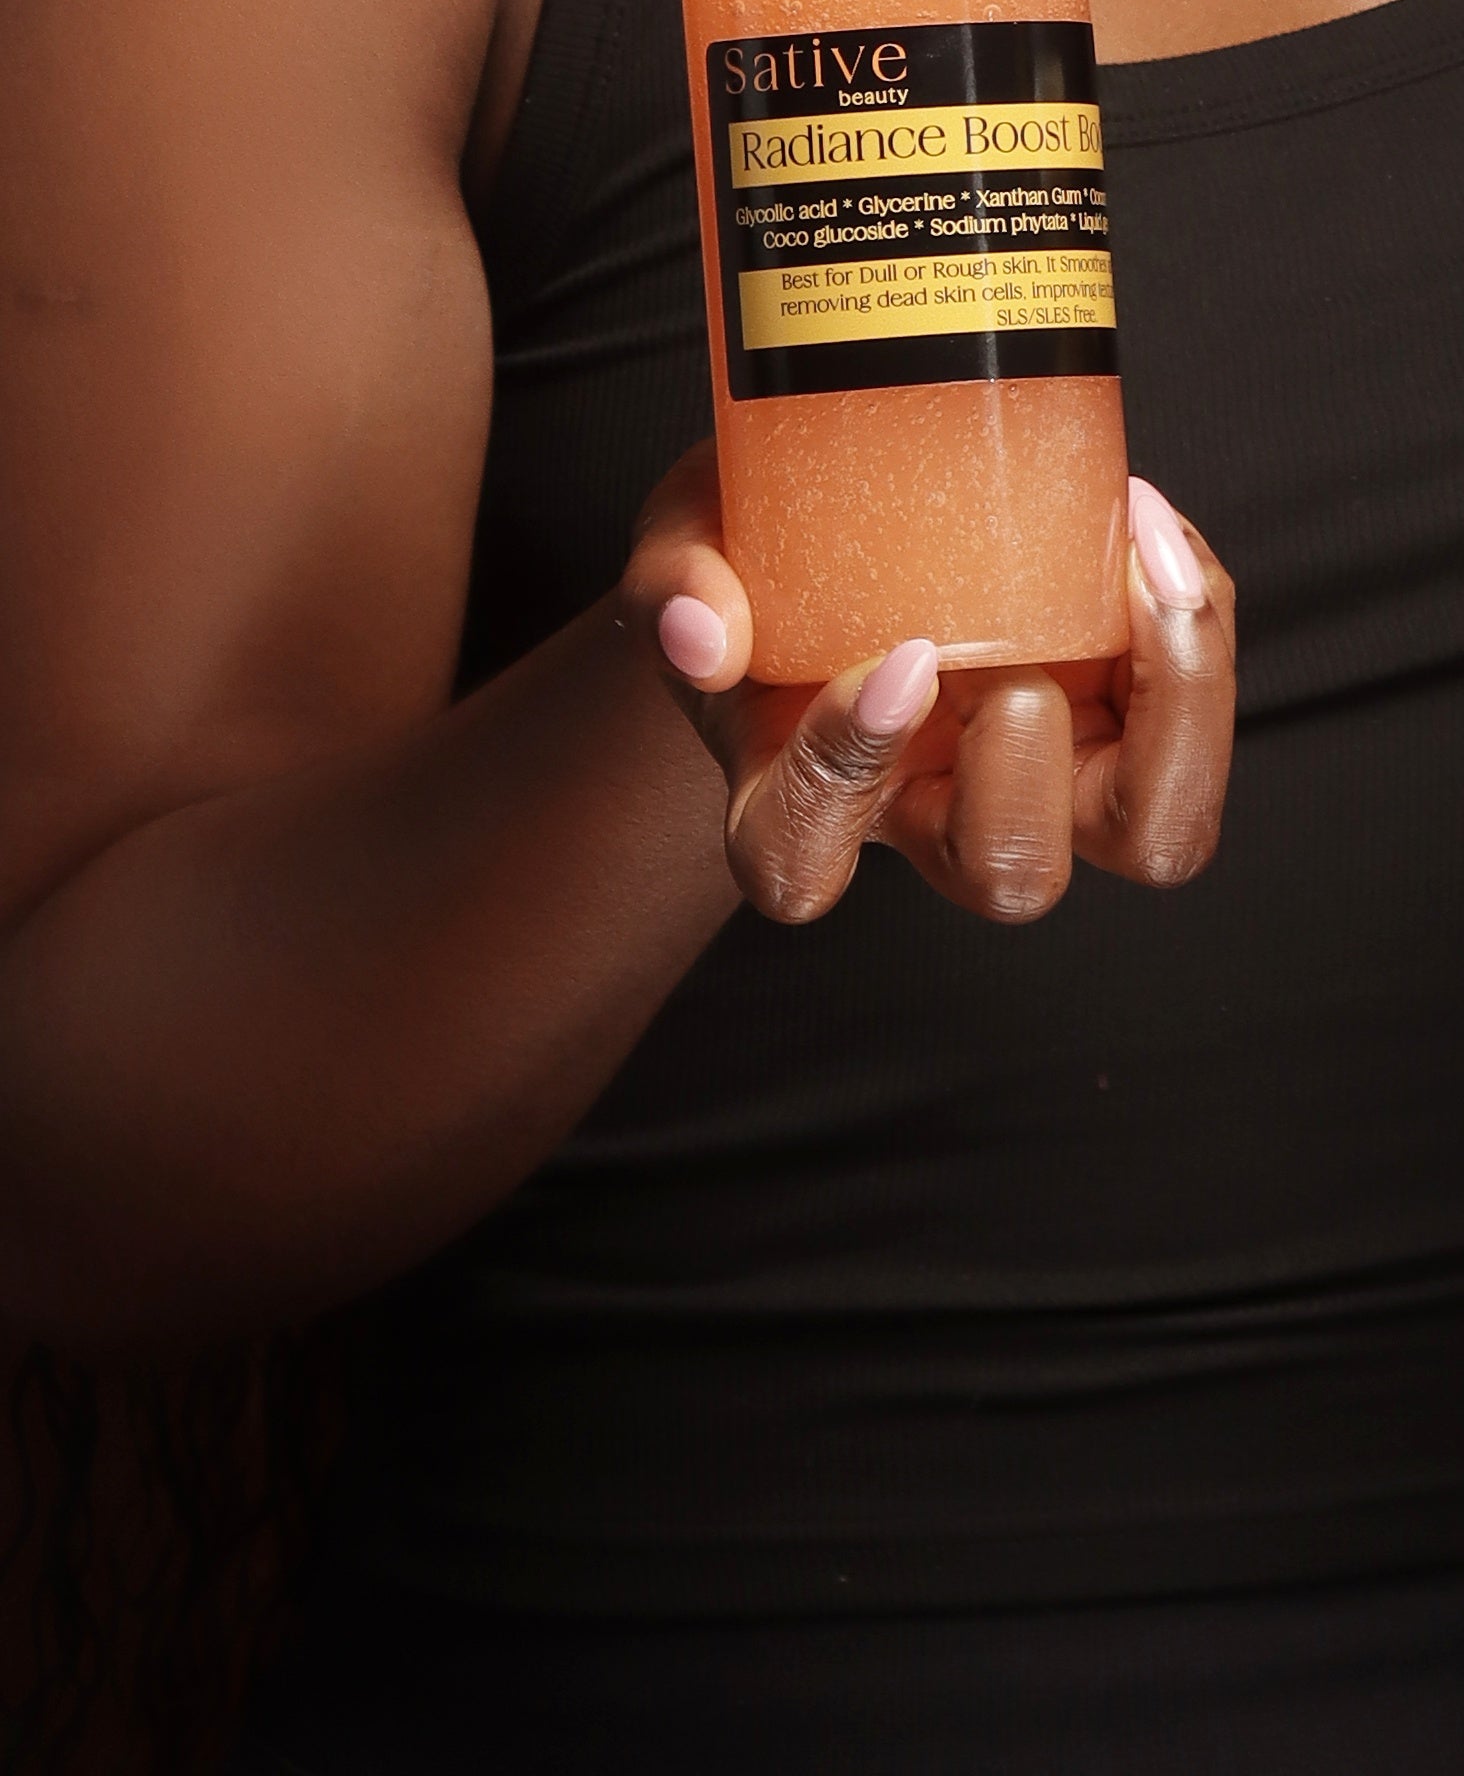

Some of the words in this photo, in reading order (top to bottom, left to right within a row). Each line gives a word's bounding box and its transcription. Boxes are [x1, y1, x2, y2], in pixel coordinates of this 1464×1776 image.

[725, 38, 908, 95] Sative
[838, 87, 909, 107] beauty
[742, 124, 947, 171] Radiance
[963, 114, 1073, 156] Boost
[1077, 113, 1102, 154] Bo
[735, 202, 795, 228] Glycolic
[798, 198, 838, 221] acid
[858, 192, 956, 218] Glycerine
[975, 187, 1050, 209] Xanthan
[1051, 186, 1083, 206] Gum
[763, 230, 810, 249] Coco
[813, 220, 910, 249] glucoside
[930, 215, 1008, 237] Sodium
[1010, 212, 1069, 237] phytata
[782, 272, 820, 291] Best
[825, 267, 853, 287] for
[860, 263, 898, 284] Dull
[903, 266, 926, 281] or
[932, 257, 997, 280] Rough
[1046, 256, 1057, 273] It
[780, 293, 872, 317] removing
[876, 288, 928, 309] dead
[933, 285, 976, 305] skin
[1031, 280, 1098, 302] improving
[996, 306, 1071, 327] SLS/SLES
